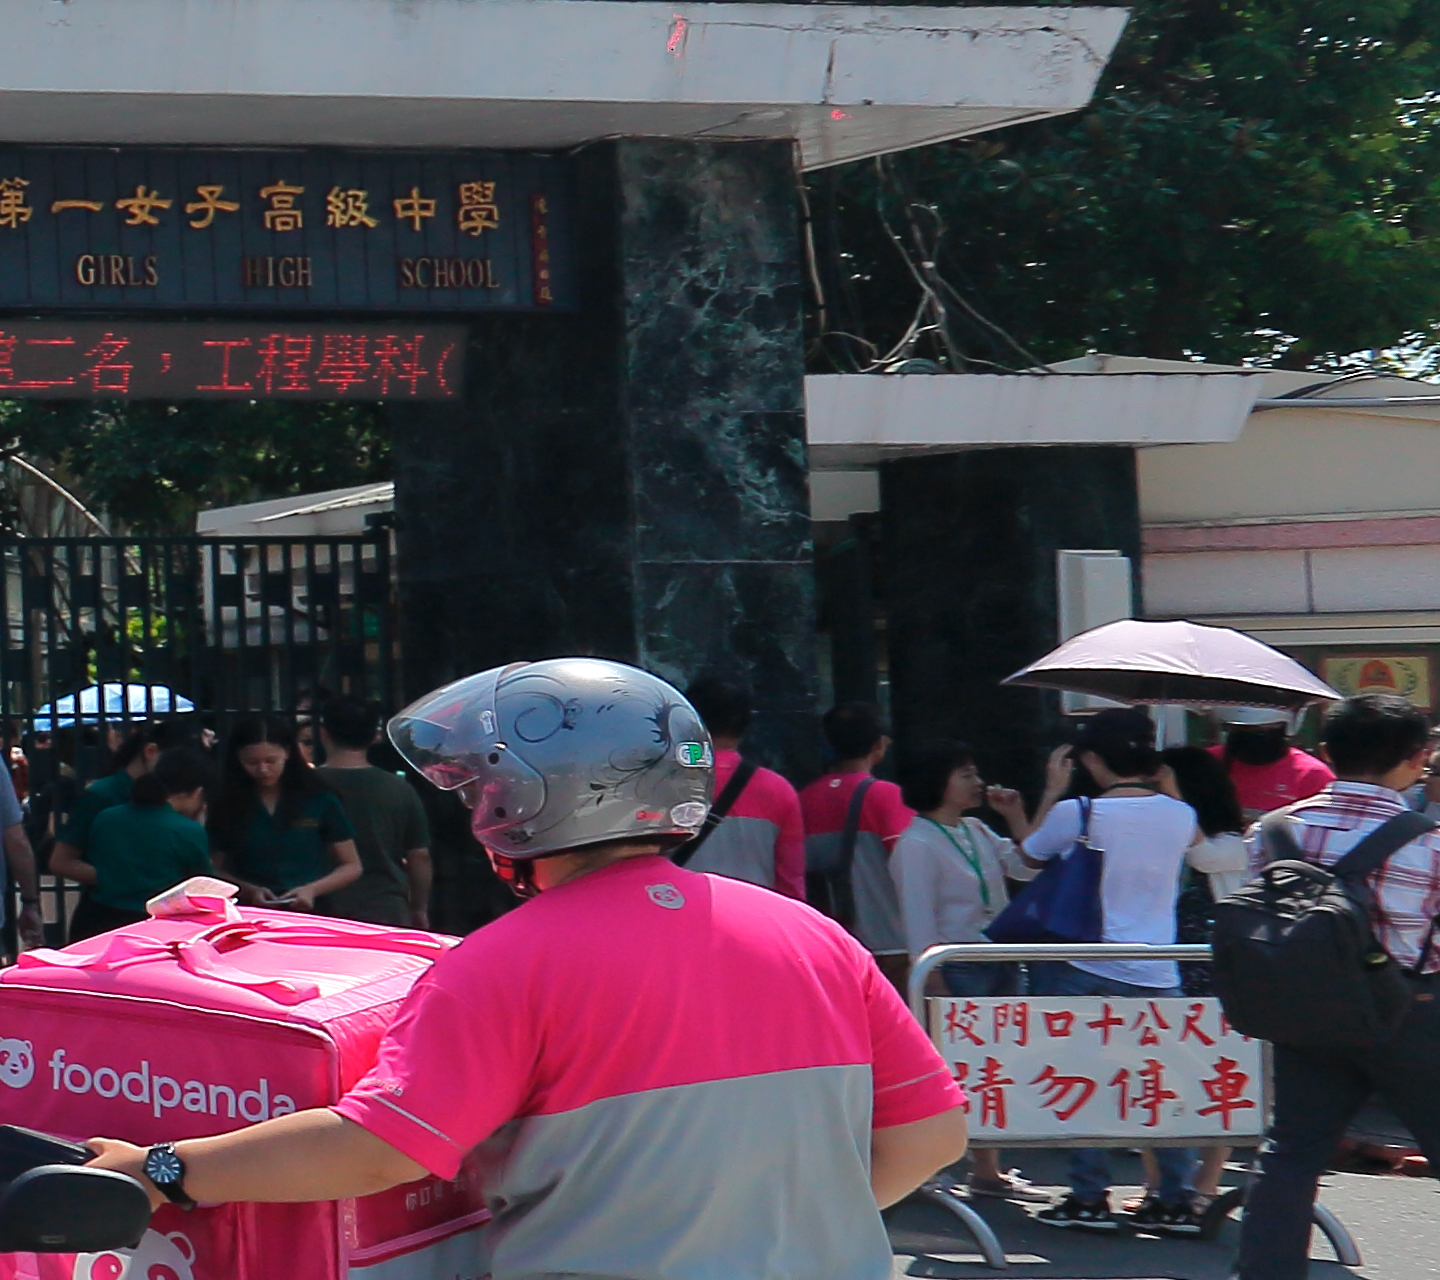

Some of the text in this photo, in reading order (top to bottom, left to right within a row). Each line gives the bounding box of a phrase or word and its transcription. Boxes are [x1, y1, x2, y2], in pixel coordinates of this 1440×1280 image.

[77, 254, 158, 286] GIRLS
[244, 257, 312, 287] HIGH
[401, 258, 500, 288] SCHOOL
[49, 1050, 298, 1122] foodpanda
[953, 1056, 1256, 1131] 請勿停車
